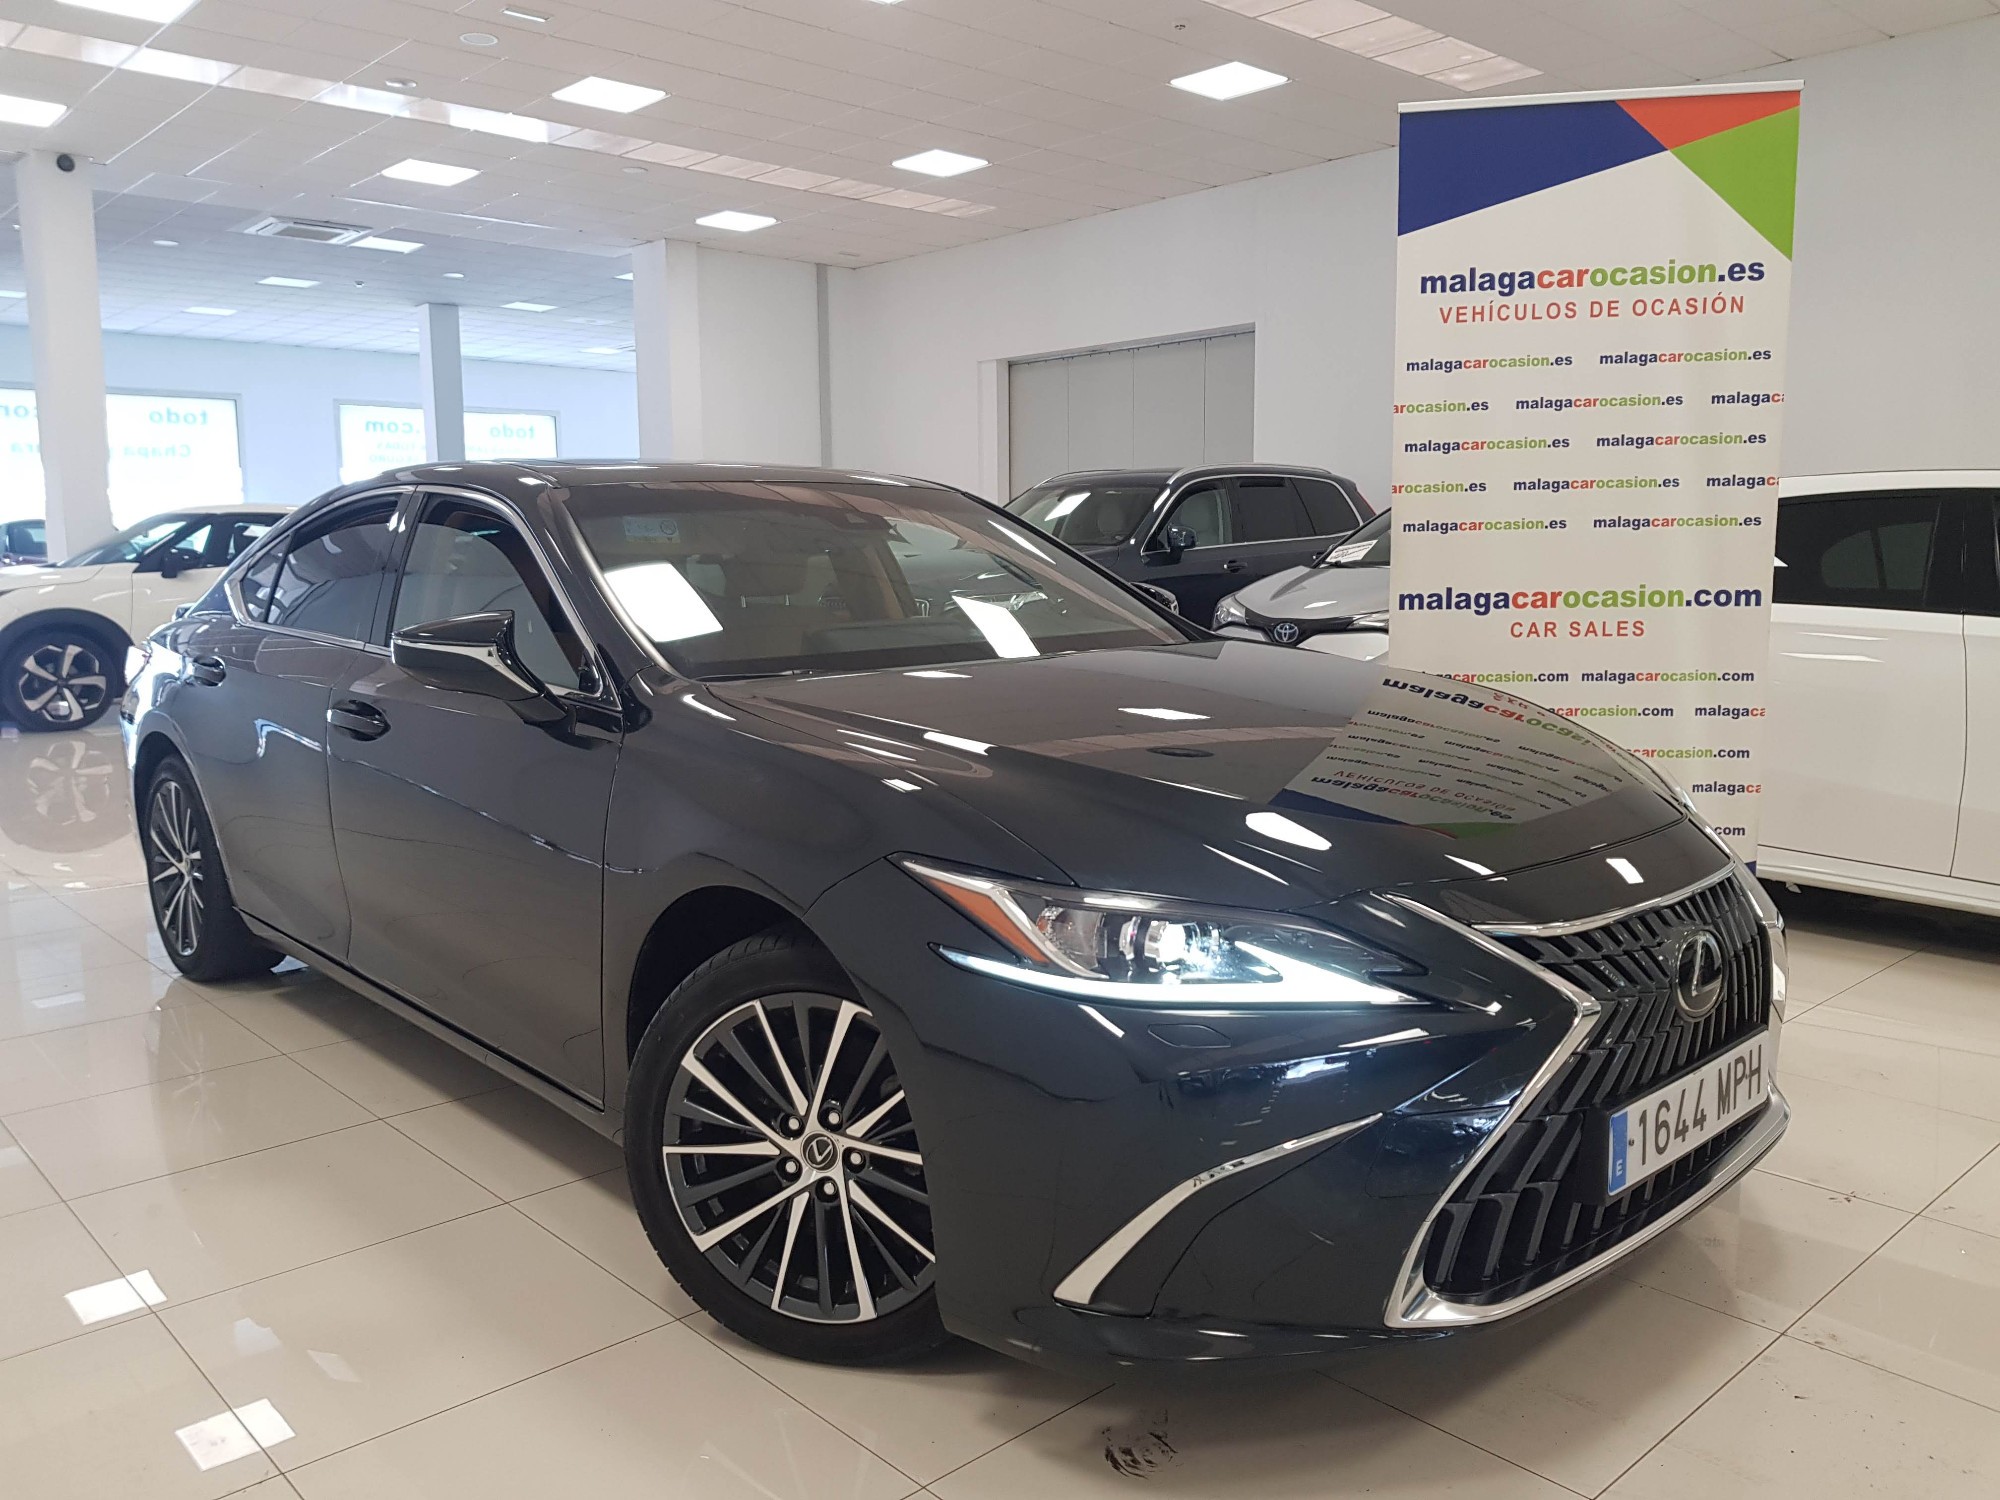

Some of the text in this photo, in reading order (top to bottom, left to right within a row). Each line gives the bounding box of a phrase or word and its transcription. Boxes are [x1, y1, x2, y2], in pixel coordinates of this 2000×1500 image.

[1420, 258, 1766, 297] malagacarocasion.es
[1439, 291, 1744, 324] VEHÍCULOS DE OCASIÓN
[1406, 348, 1772, 373] malagacarocasion.es malagacarocasion.es
[1515, 393, 1684, 412] malagacarocasion.es
[1711, 391, 1784, 407] malagac
[1404, 431, 1767, 454] malagacarocasion.es malagacarocasion.es
[1513, 475, 1680, 493] malagacarocasion.es
[1706, 473, 1779, 490] malagac
[1403, 514, 1762, 535] malagacarocasion.es malagacarocasion.es
[1398, 583, 1762, 616] malagacarocasion.com
[1510, 620, 1645, 638] CAR SALES
[1581, 669, 1755, 685] malagacarocasion.com
[1638, 1043, 1763, 1167] 1644 MPH
[1615, 1158, 1624, 1177] E
